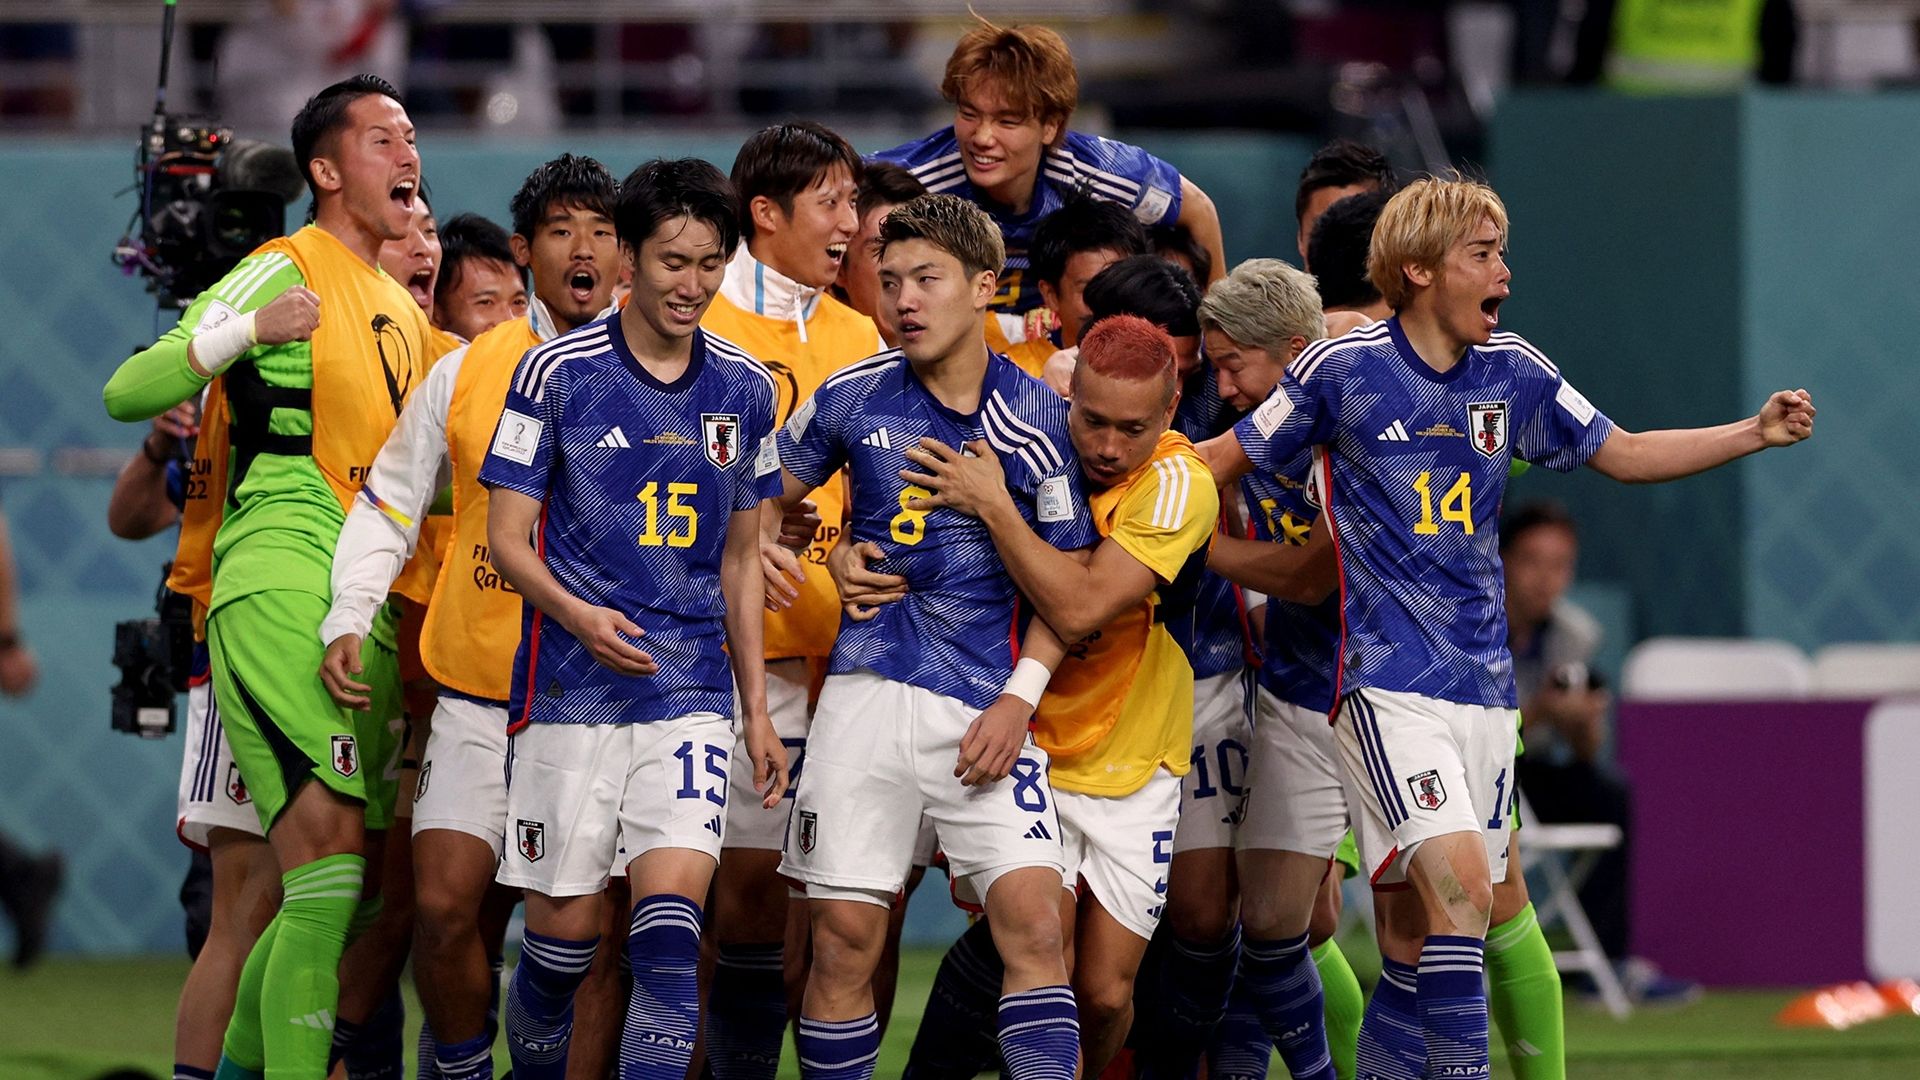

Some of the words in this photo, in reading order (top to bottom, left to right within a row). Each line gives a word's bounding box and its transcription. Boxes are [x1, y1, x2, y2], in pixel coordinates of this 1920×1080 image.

[350, 466, 372, 482] FI
[636, 481, 698, 548] 15
[890, 485, 932, 546] 8
[1413, 471, 1474, 535] 14
[813, 526, 840, 542] UP
[673, 741, 728, 808] 15
[1009, 757, 1048, 814] 8
[1190, 738, 1250, 799] 10
[512, 1022, 574, 1052] JAPA
[642, 1034, 696, 1050] JAPA
[1442, 1063, 1490, 1076] JAPA
